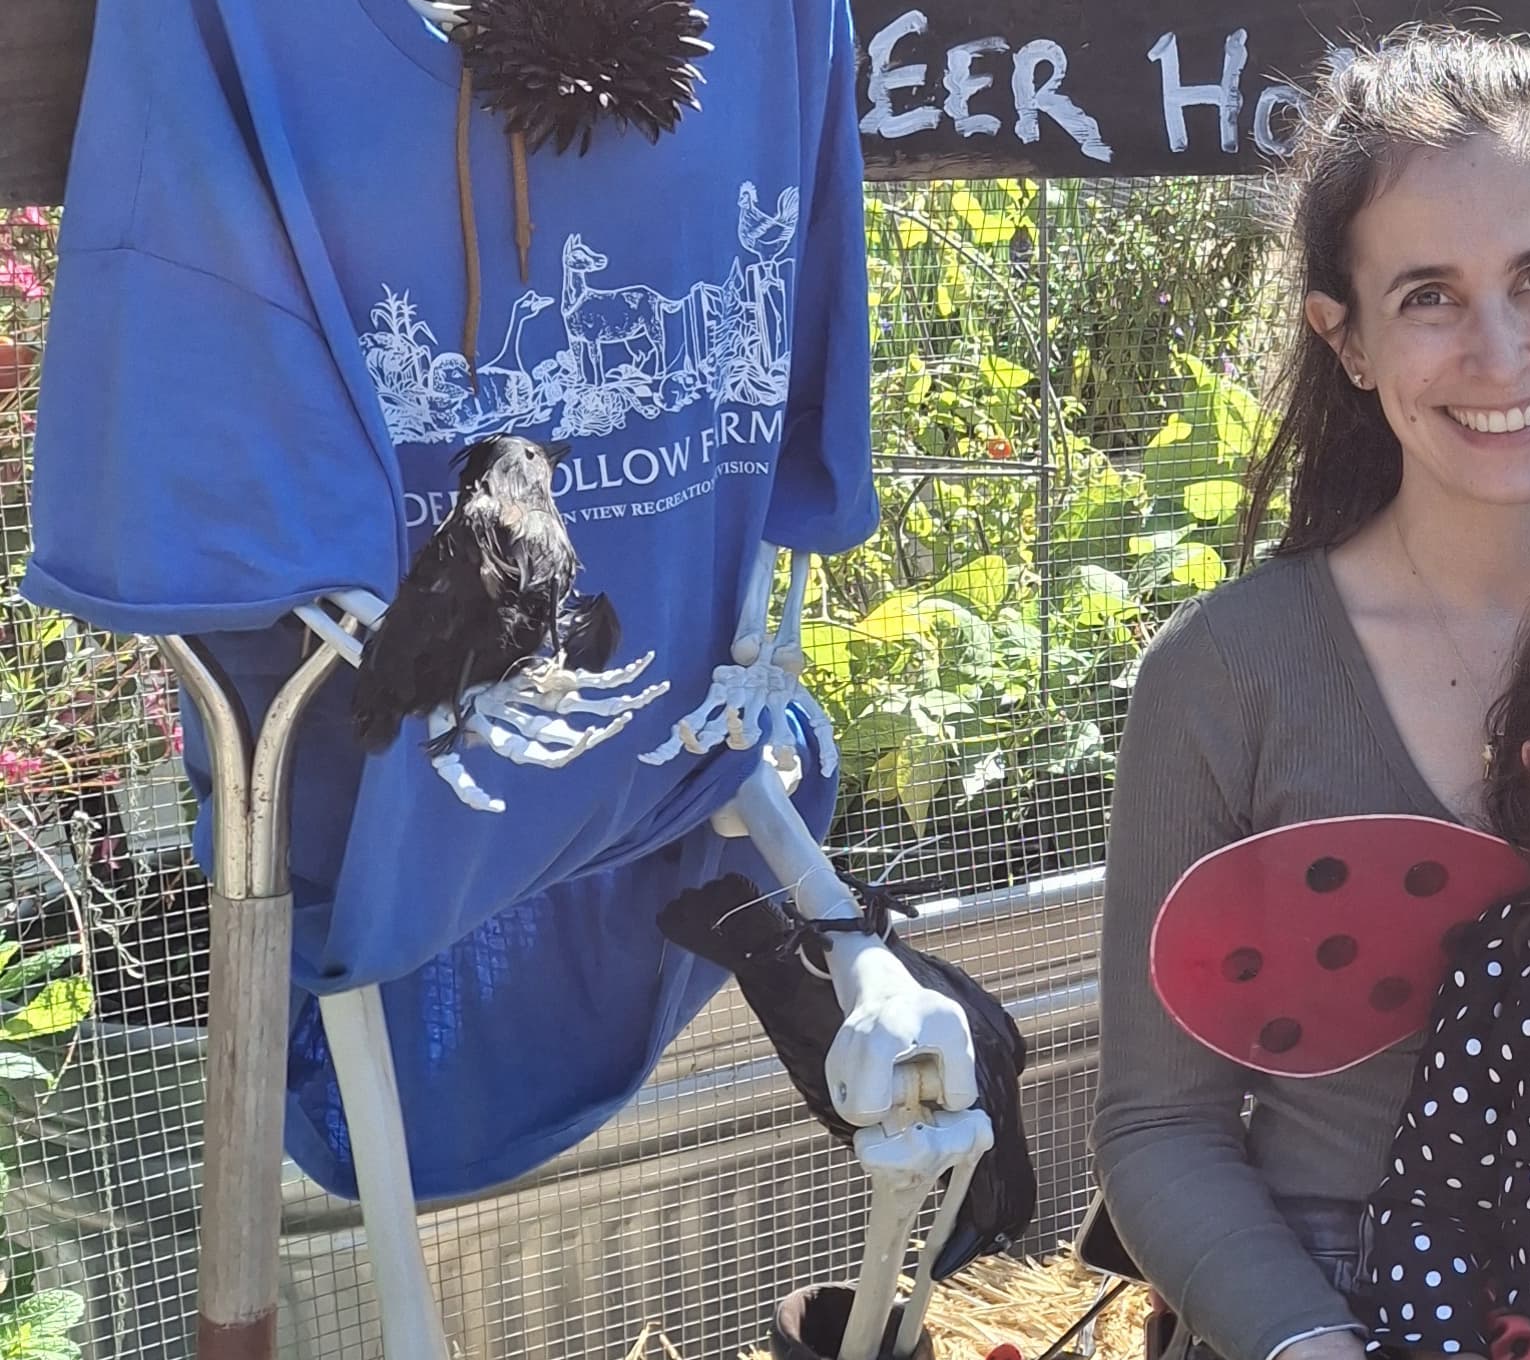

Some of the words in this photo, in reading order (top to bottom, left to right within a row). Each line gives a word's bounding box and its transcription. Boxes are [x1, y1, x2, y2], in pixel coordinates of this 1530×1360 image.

[858, 9, 1114, 163] EER
[551, 436, 691, 498] OLLOW
[701, 409, 783, 463] FRM
[581, 504, 627, 521] VIEW
